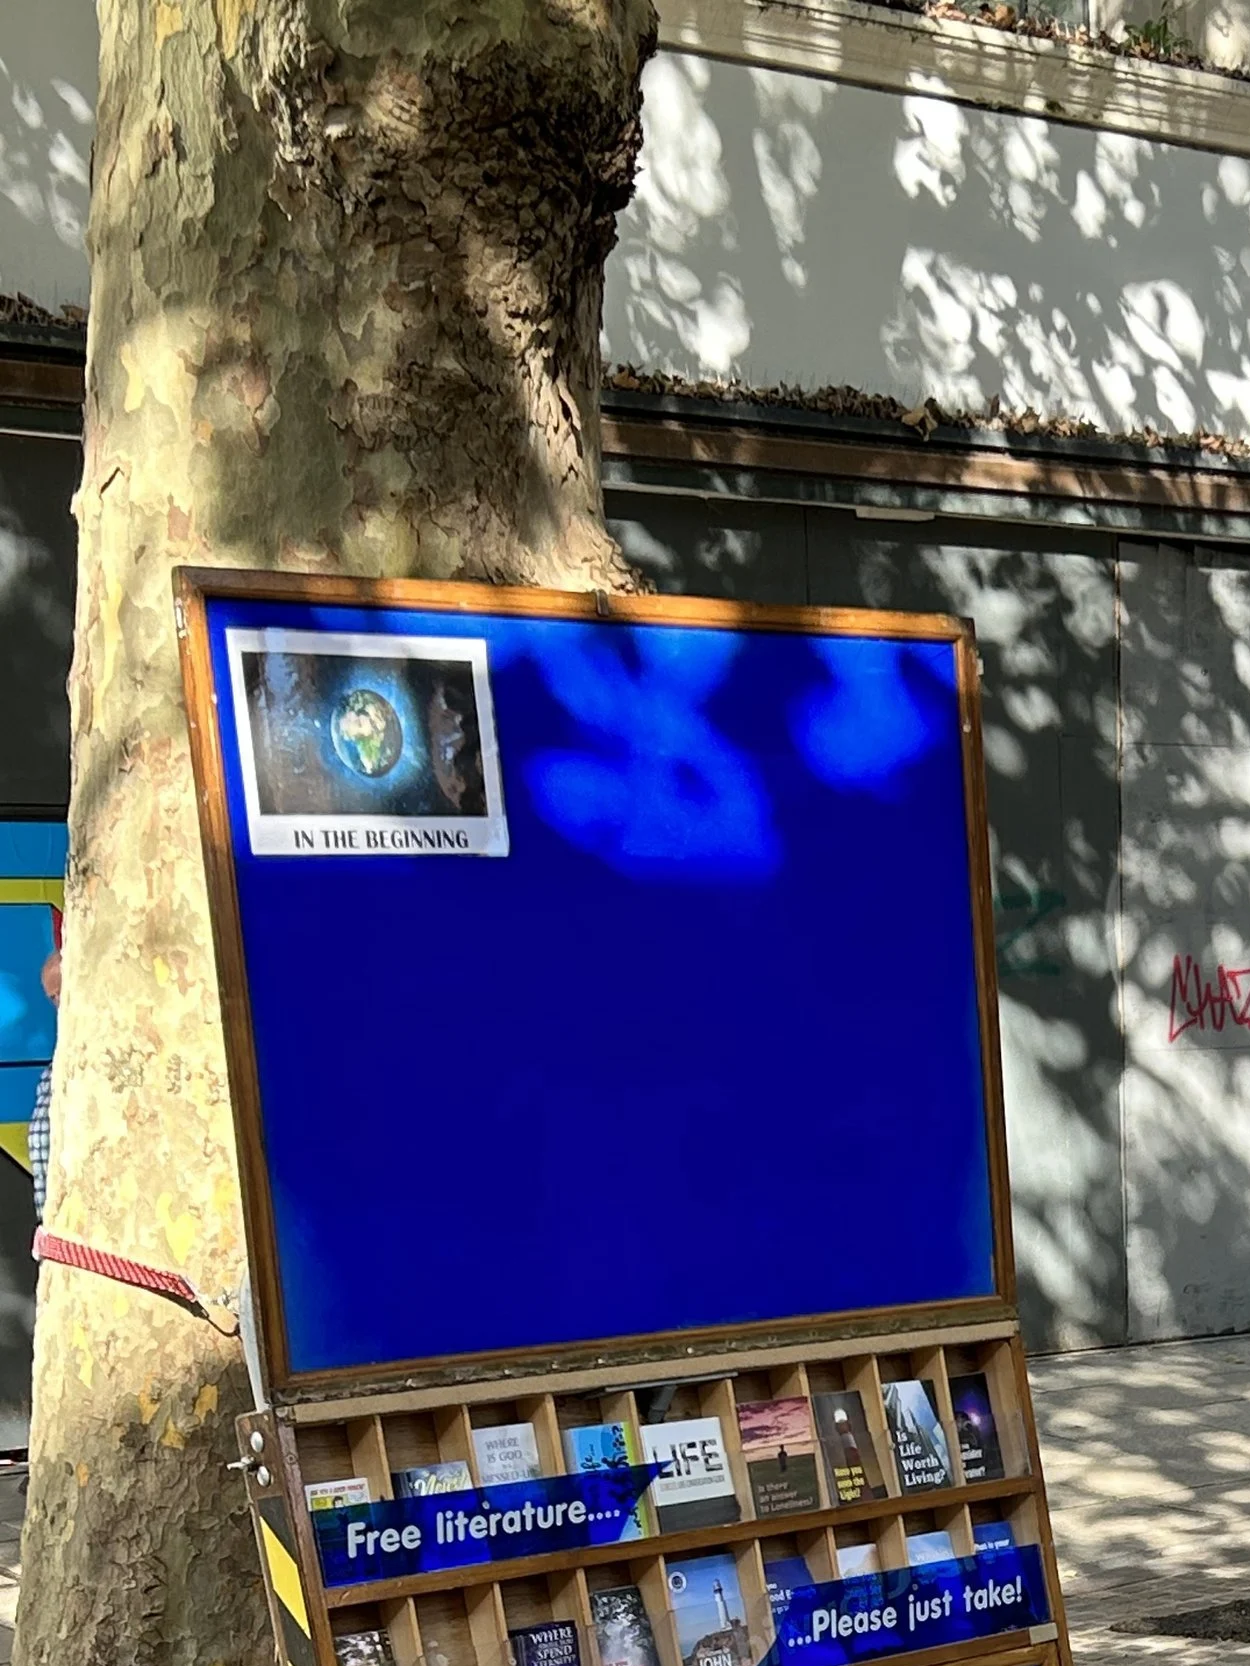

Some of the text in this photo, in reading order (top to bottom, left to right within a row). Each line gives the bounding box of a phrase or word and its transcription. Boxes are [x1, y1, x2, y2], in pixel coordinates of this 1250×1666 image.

[293, 829, 469, 850] IN THE BEGINNING
[485, 1437, 520, 1450] WHERE
[896, 1431, 908, 1442] Is
[486, 1450, 523, 1463] IS GOD
[899, 1442, 922, 1457] Life
[652, 1439, 724, 1479] LIFE
[901, 1456, 940, 1472] Worth
[904, 1469, 947, 1486] Living?
[347, 1521, 422, 1559] Free
[908, 1589, 953, 1632] just
[963, 1574, 1022, 1613] take!
[529, 1626, 574, 1644] WHERE
[536, 1645, 573, 1660] SPEND
